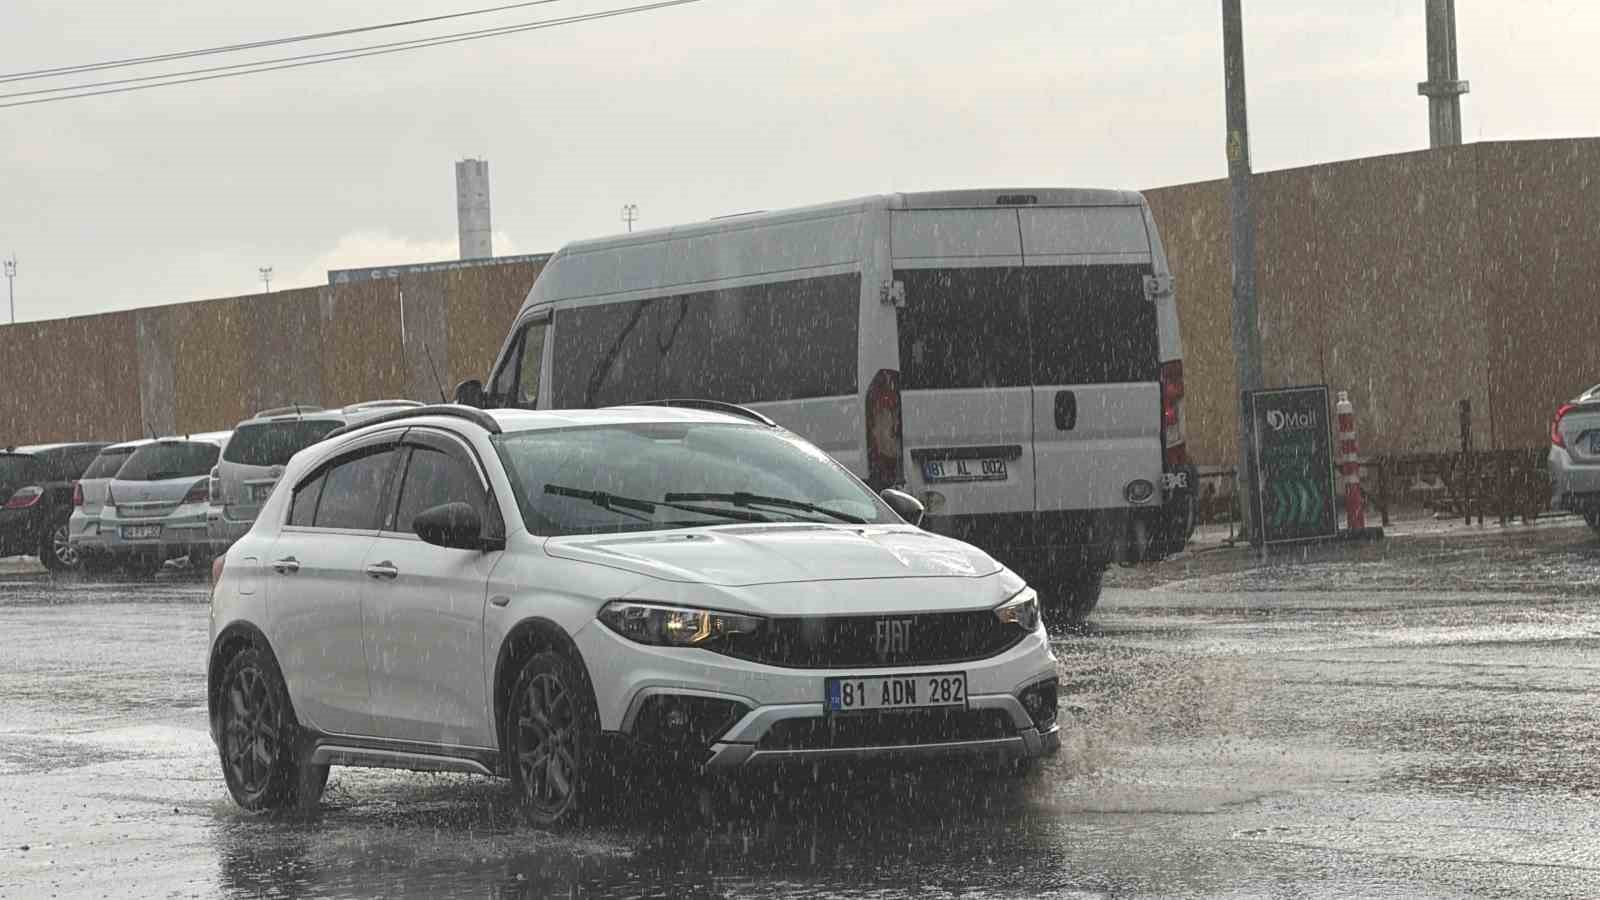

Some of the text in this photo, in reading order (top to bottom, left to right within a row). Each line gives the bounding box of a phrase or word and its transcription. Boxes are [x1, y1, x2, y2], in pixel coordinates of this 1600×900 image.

[930, 462, 945, 476] 81
[875, 619, 913, 653] FIAT
[842, 678, 963, 706] 81 ADN 282
